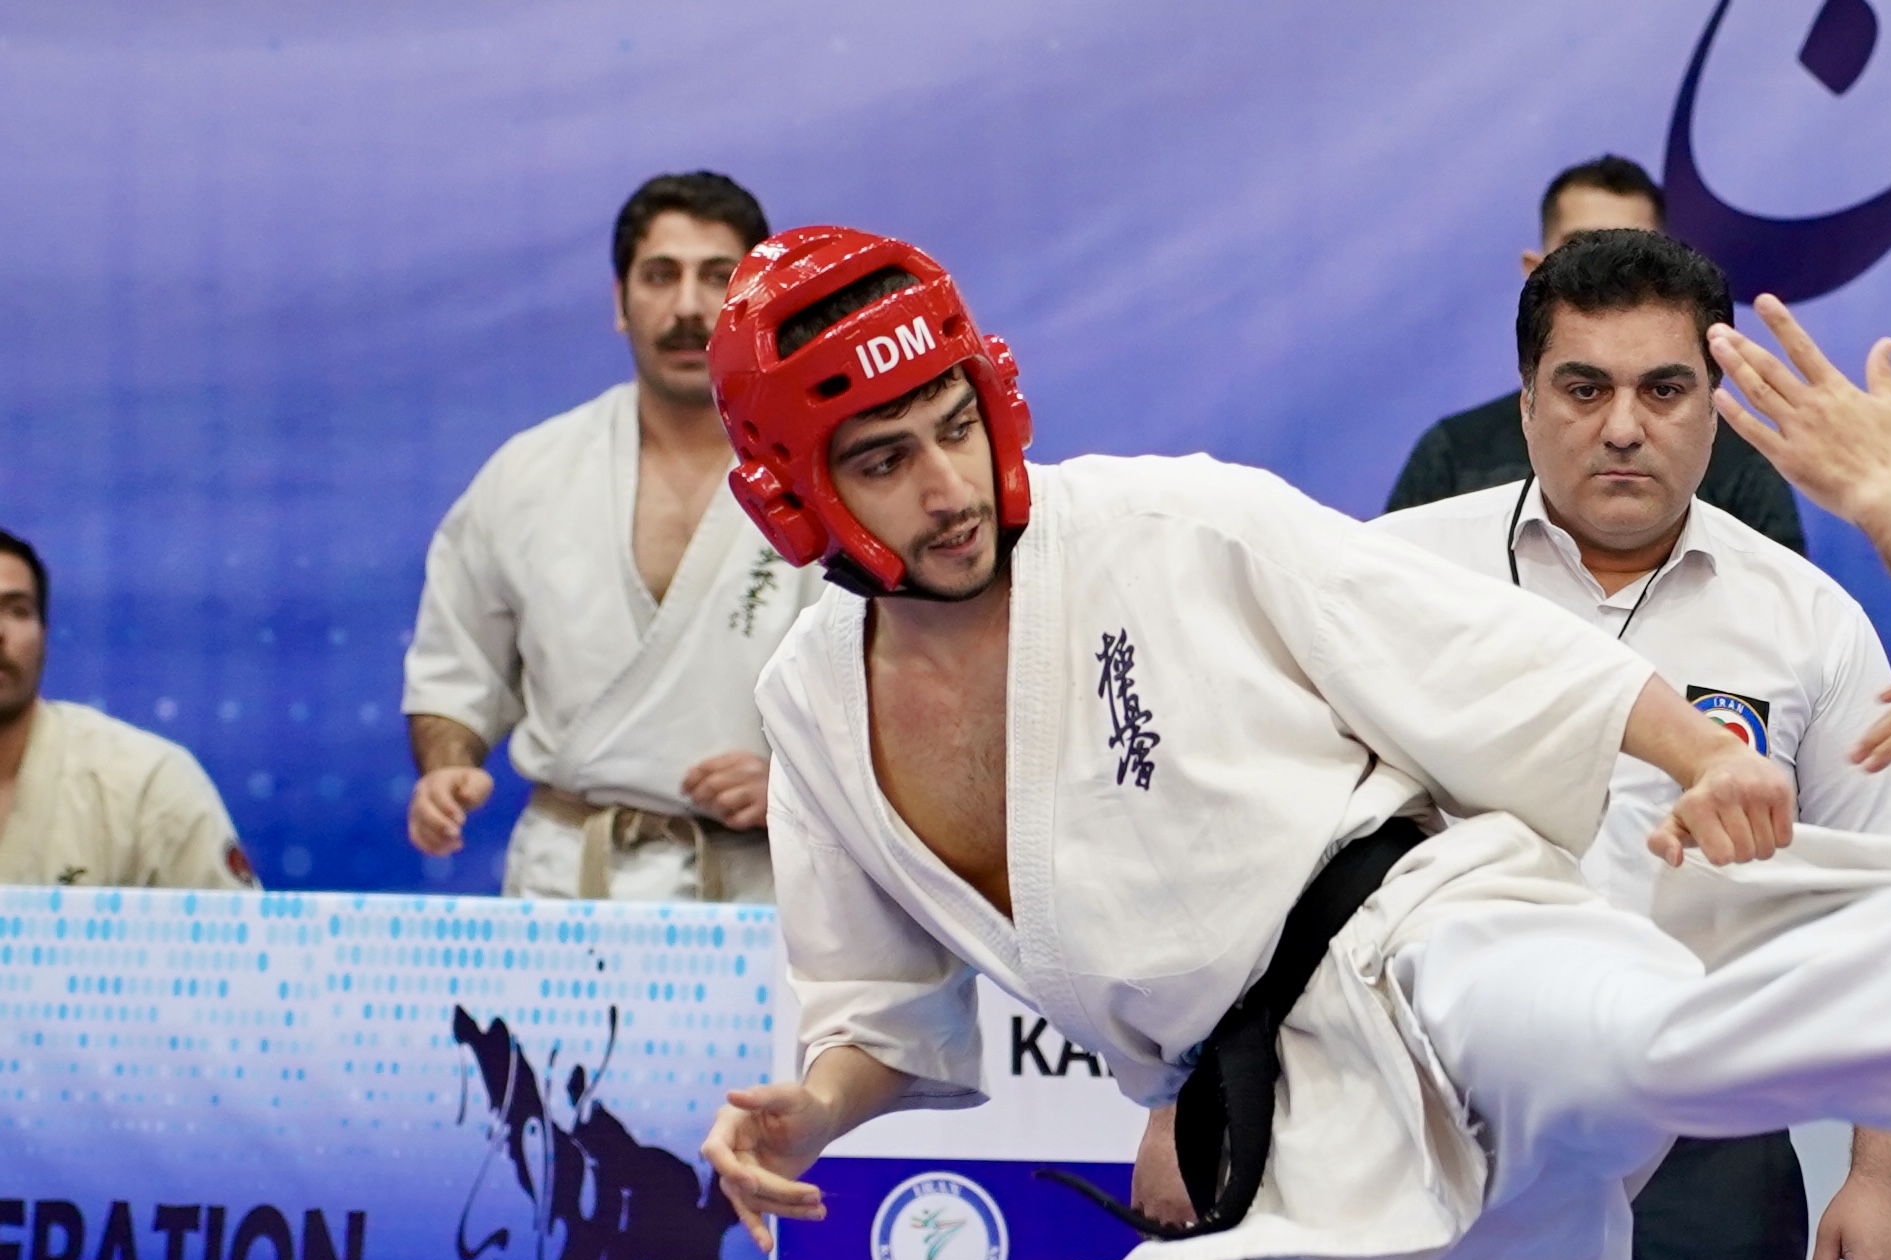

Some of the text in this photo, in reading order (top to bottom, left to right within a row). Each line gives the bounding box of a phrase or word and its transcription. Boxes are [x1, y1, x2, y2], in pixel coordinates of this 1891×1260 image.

[855, 315, 936, 379] IDM
[1713, 697, 1744, 714] IRAN
[1011, 1015, 1114, 1077] KA
